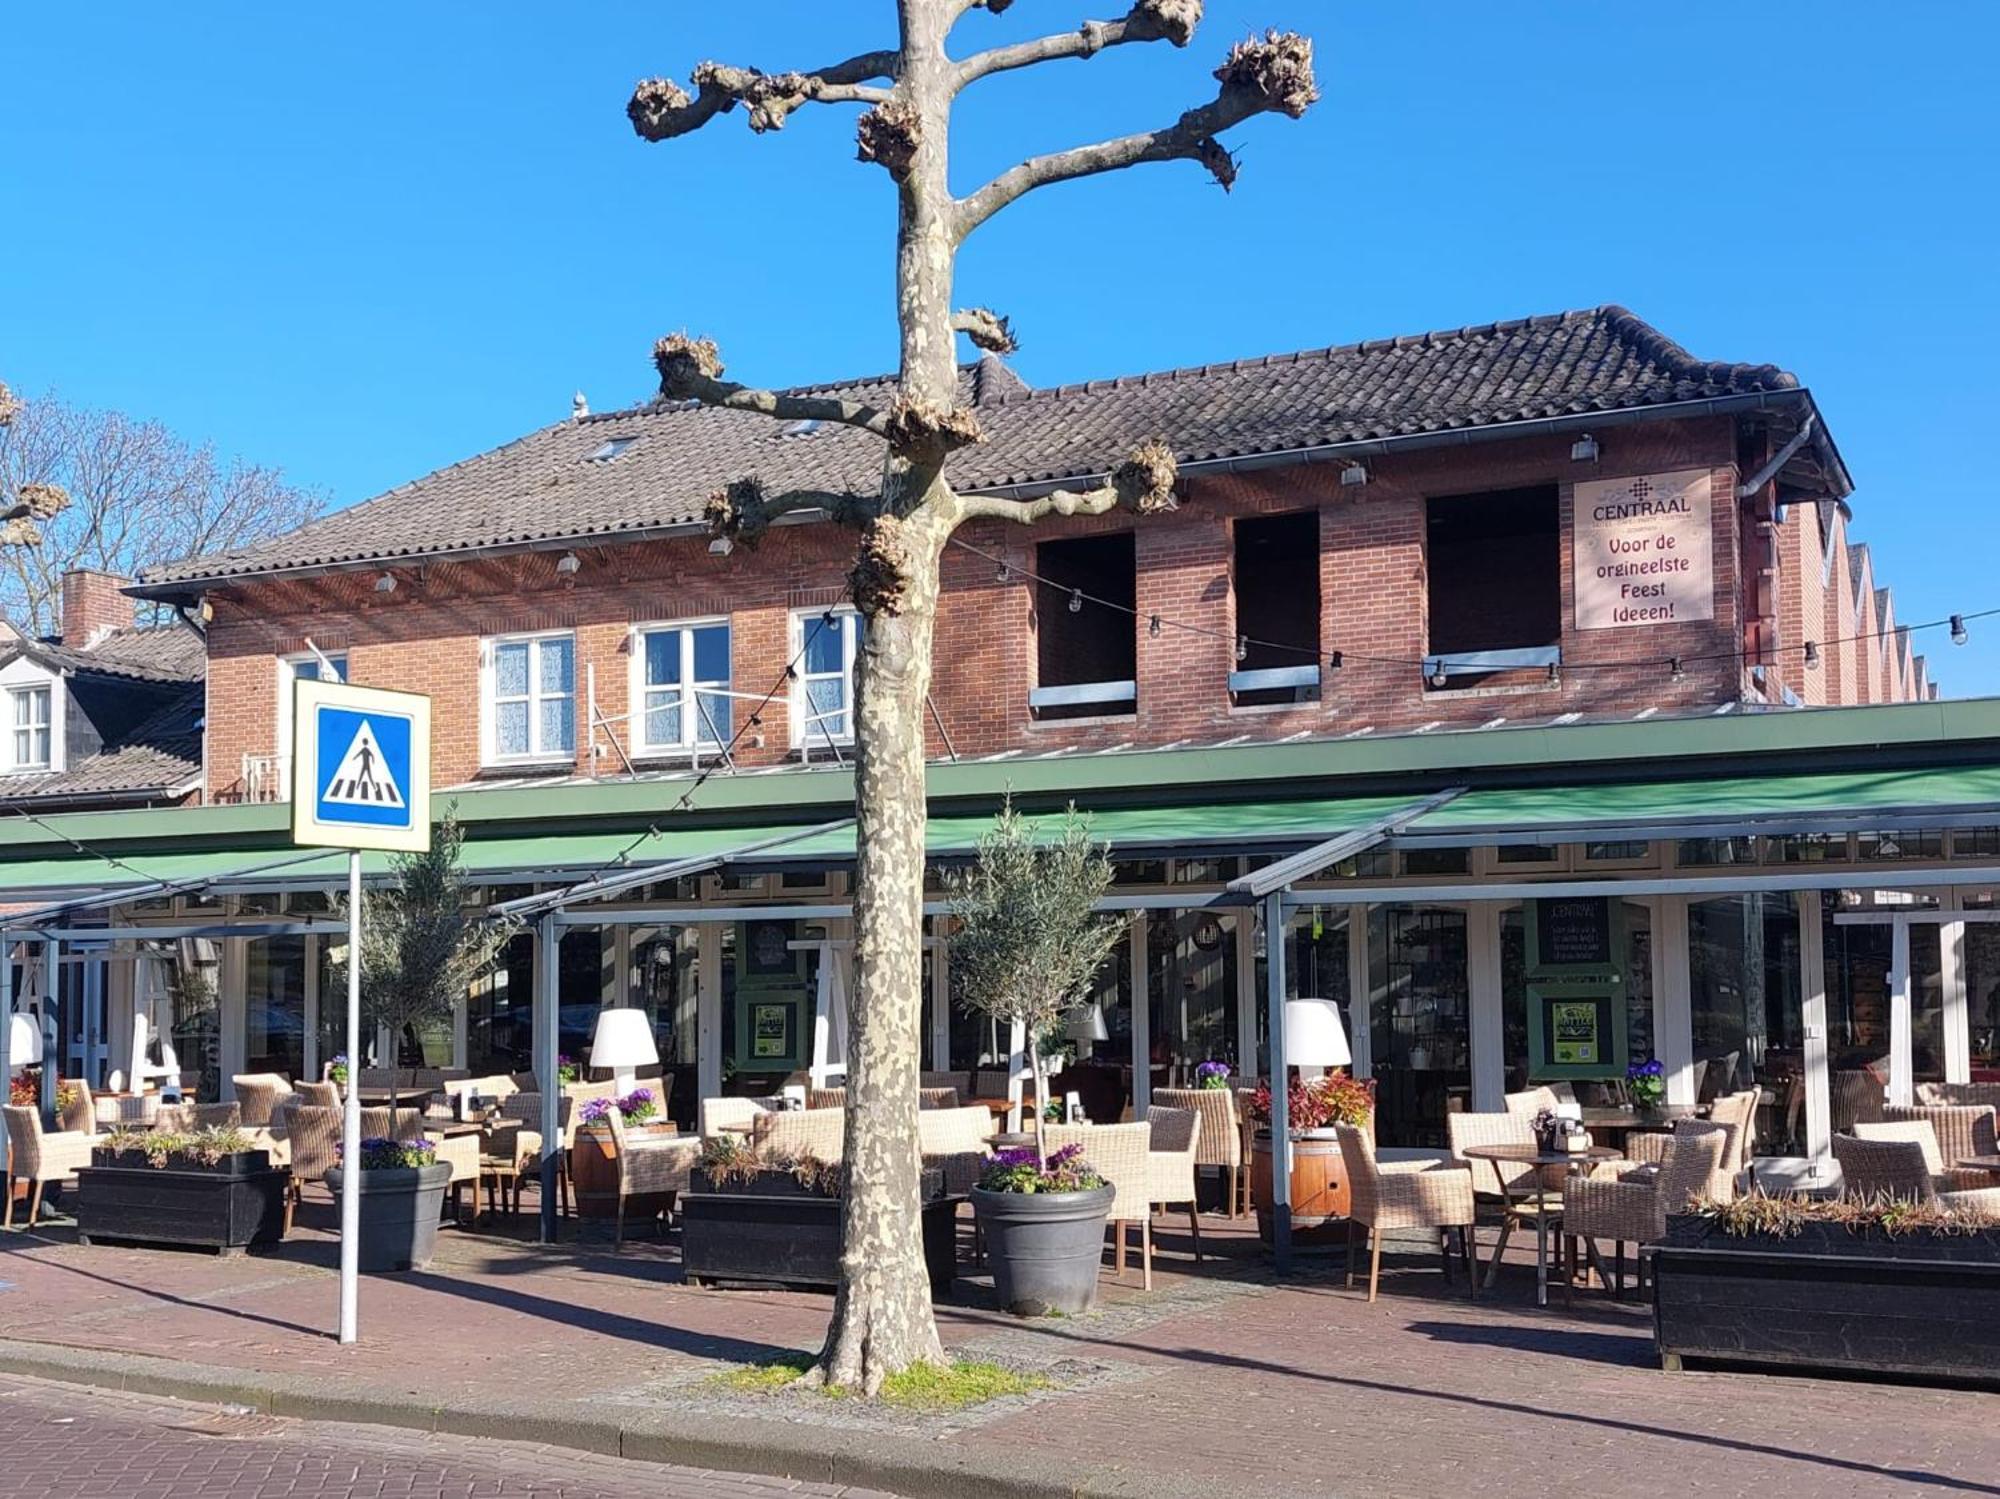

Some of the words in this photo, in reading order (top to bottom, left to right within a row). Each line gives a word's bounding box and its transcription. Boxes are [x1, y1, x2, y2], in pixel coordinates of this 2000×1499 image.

[1593, 498, 1692, 521] CENTRAAL
[1609, 539, 1650, 554] Voor
[1656, 534, 1676, 550] de
[1596, 557, 1690, 579] orgineelste
[1620, 582, 1666, 599] Feest
[1613, 602, 1675, 623] Ideeen!
